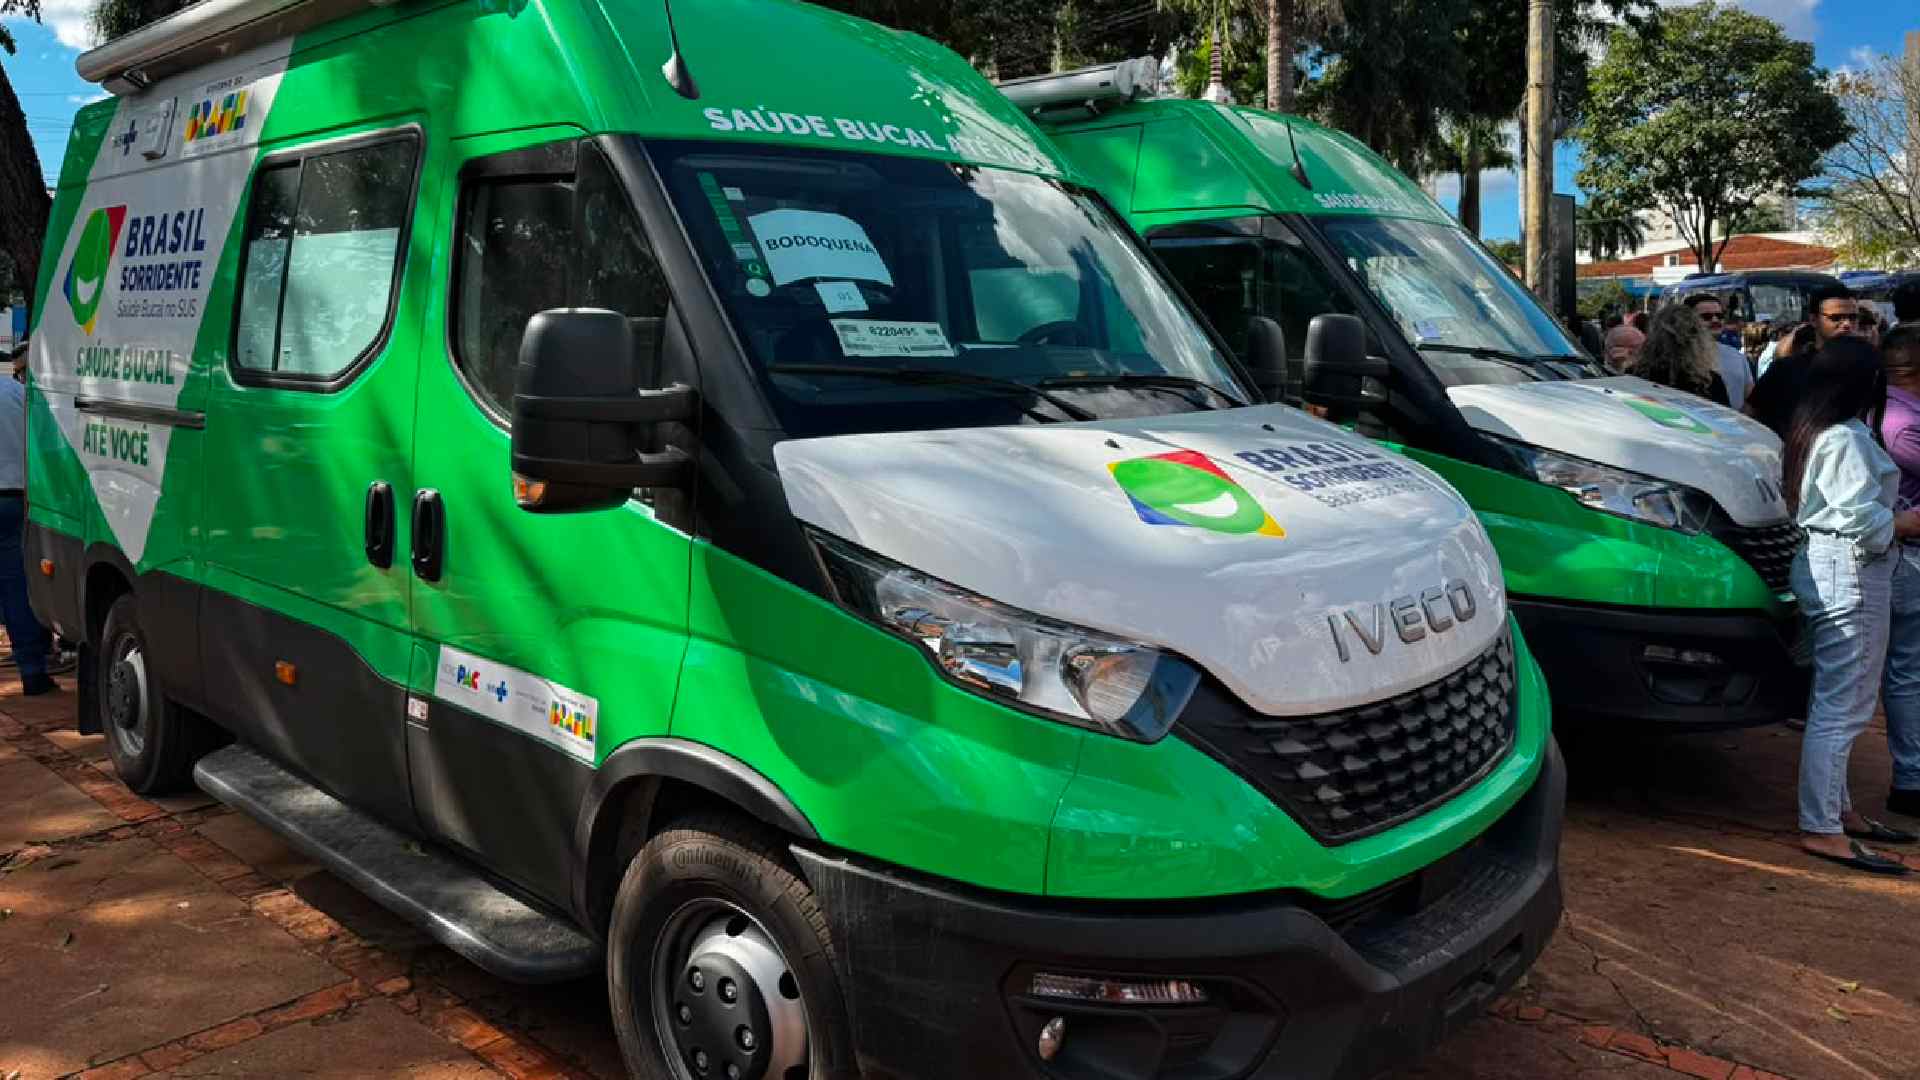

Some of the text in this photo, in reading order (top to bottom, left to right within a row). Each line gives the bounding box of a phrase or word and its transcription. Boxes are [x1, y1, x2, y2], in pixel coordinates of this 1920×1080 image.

[703, 105, 835, 138] SAÚDE
[834, 118, 946, 151] BUCAL
[125, 208, 206, 257] BRASIL
[120, 261, 202, 291] SORRIDENTE
[177, 298, 197, 318] SUS
[76, 338, 175, 384] SAÚDE BUCAL
[84, 416, 150, 466] ATÉ VOCÊ
[1233, 441, 1382, 471] BRASIL
[1327, 578, 1477, 664] IVECO
